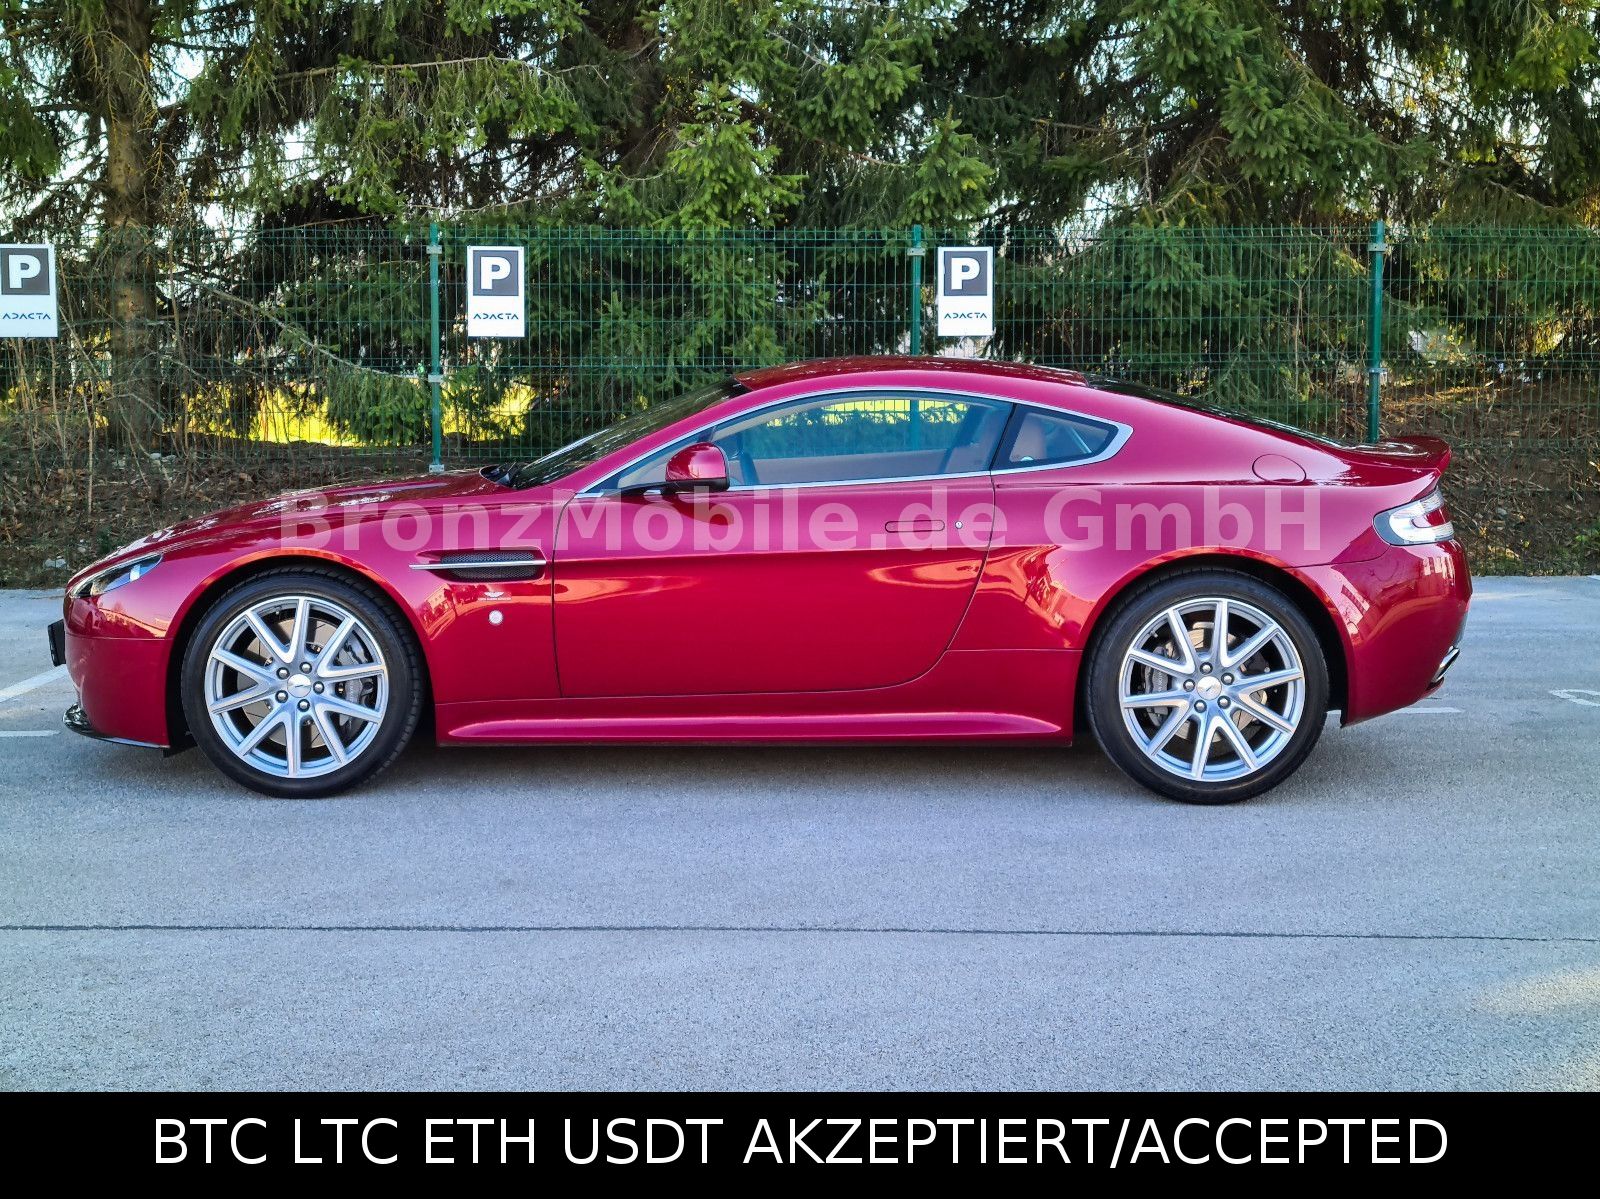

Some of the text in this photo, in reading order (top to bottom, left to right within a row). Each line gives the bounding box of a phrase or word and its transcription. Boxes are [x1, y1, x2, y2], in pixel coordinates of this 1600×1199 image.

[8, 254, 42, 289] P
[480, 256, 511, 290] P
[950, 257, 980, 290] P
[2, 312, 52, 321] ADACTA
[472, 312, 519, 320] ADACTA
[943, 311, 988, 320] ADACTA
